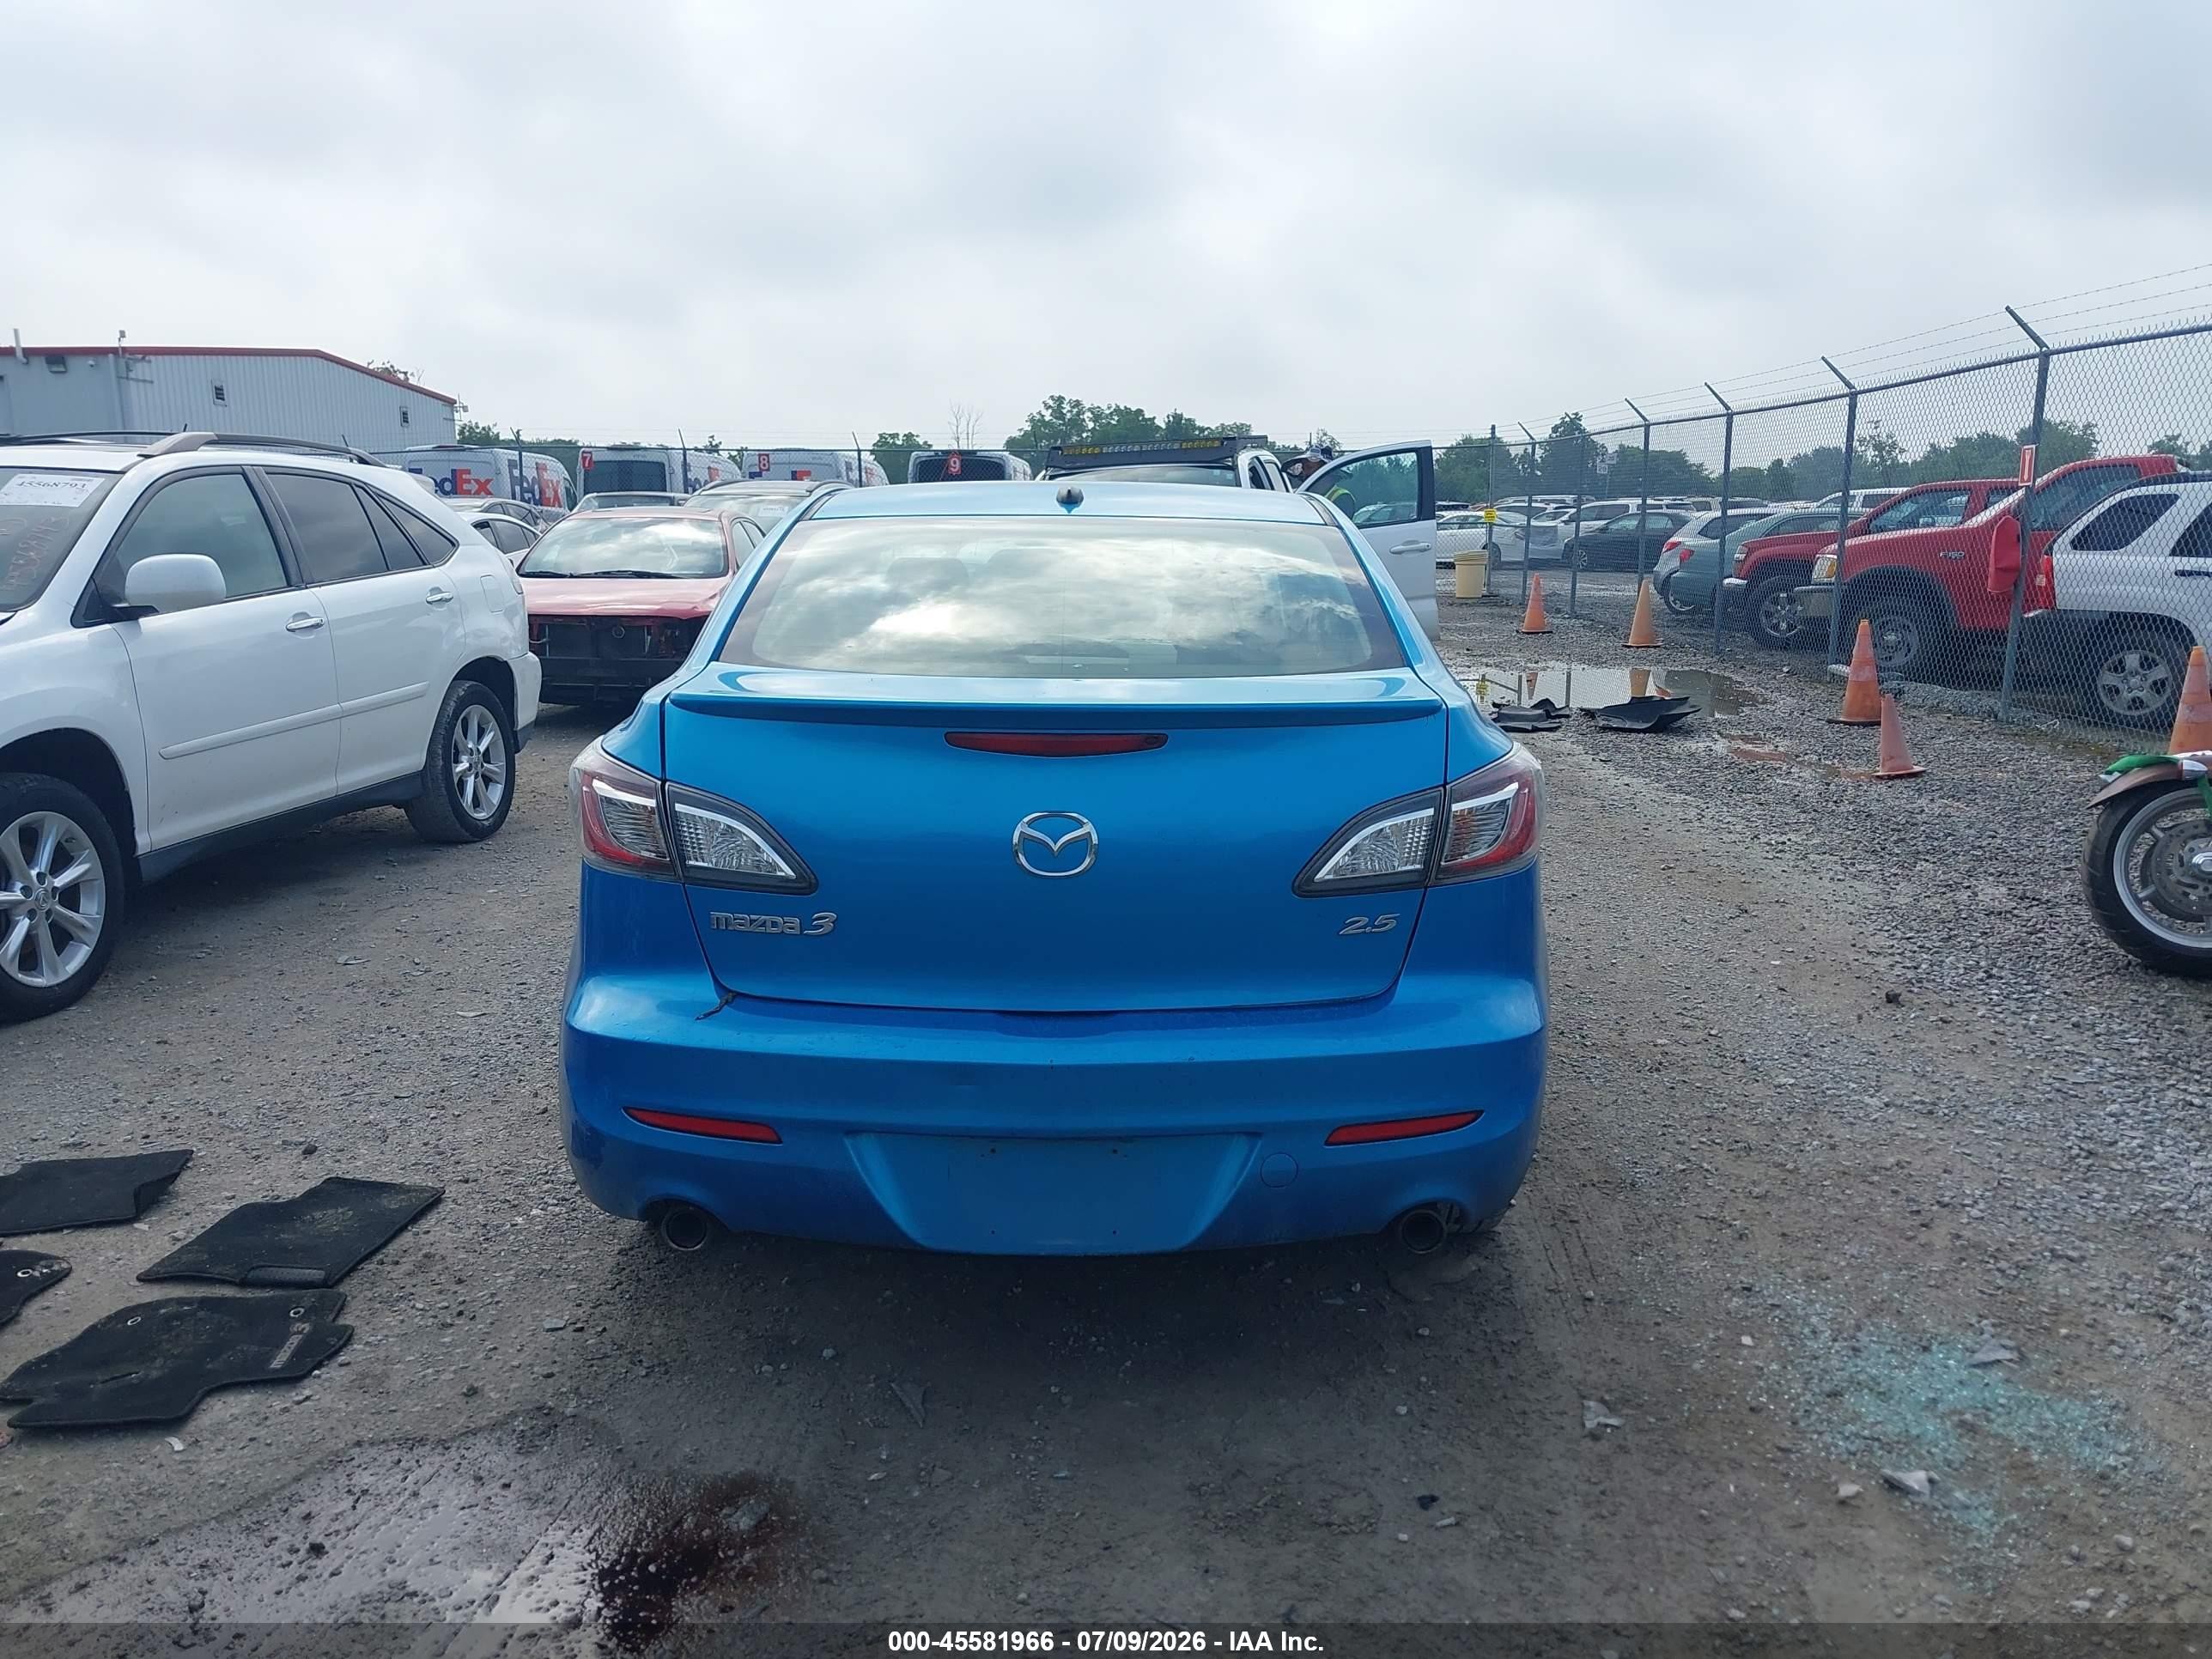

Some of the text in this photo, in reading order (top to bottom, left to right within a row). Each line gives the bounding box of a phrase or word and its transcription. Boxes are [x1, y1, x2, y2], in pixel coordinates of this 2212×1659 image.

[583, 453, 592, 468] 7
[760, 455, 769, 471] 8
[950, 457, 960, 472] 9
[1340, 914, 1401, 934] 2.5
